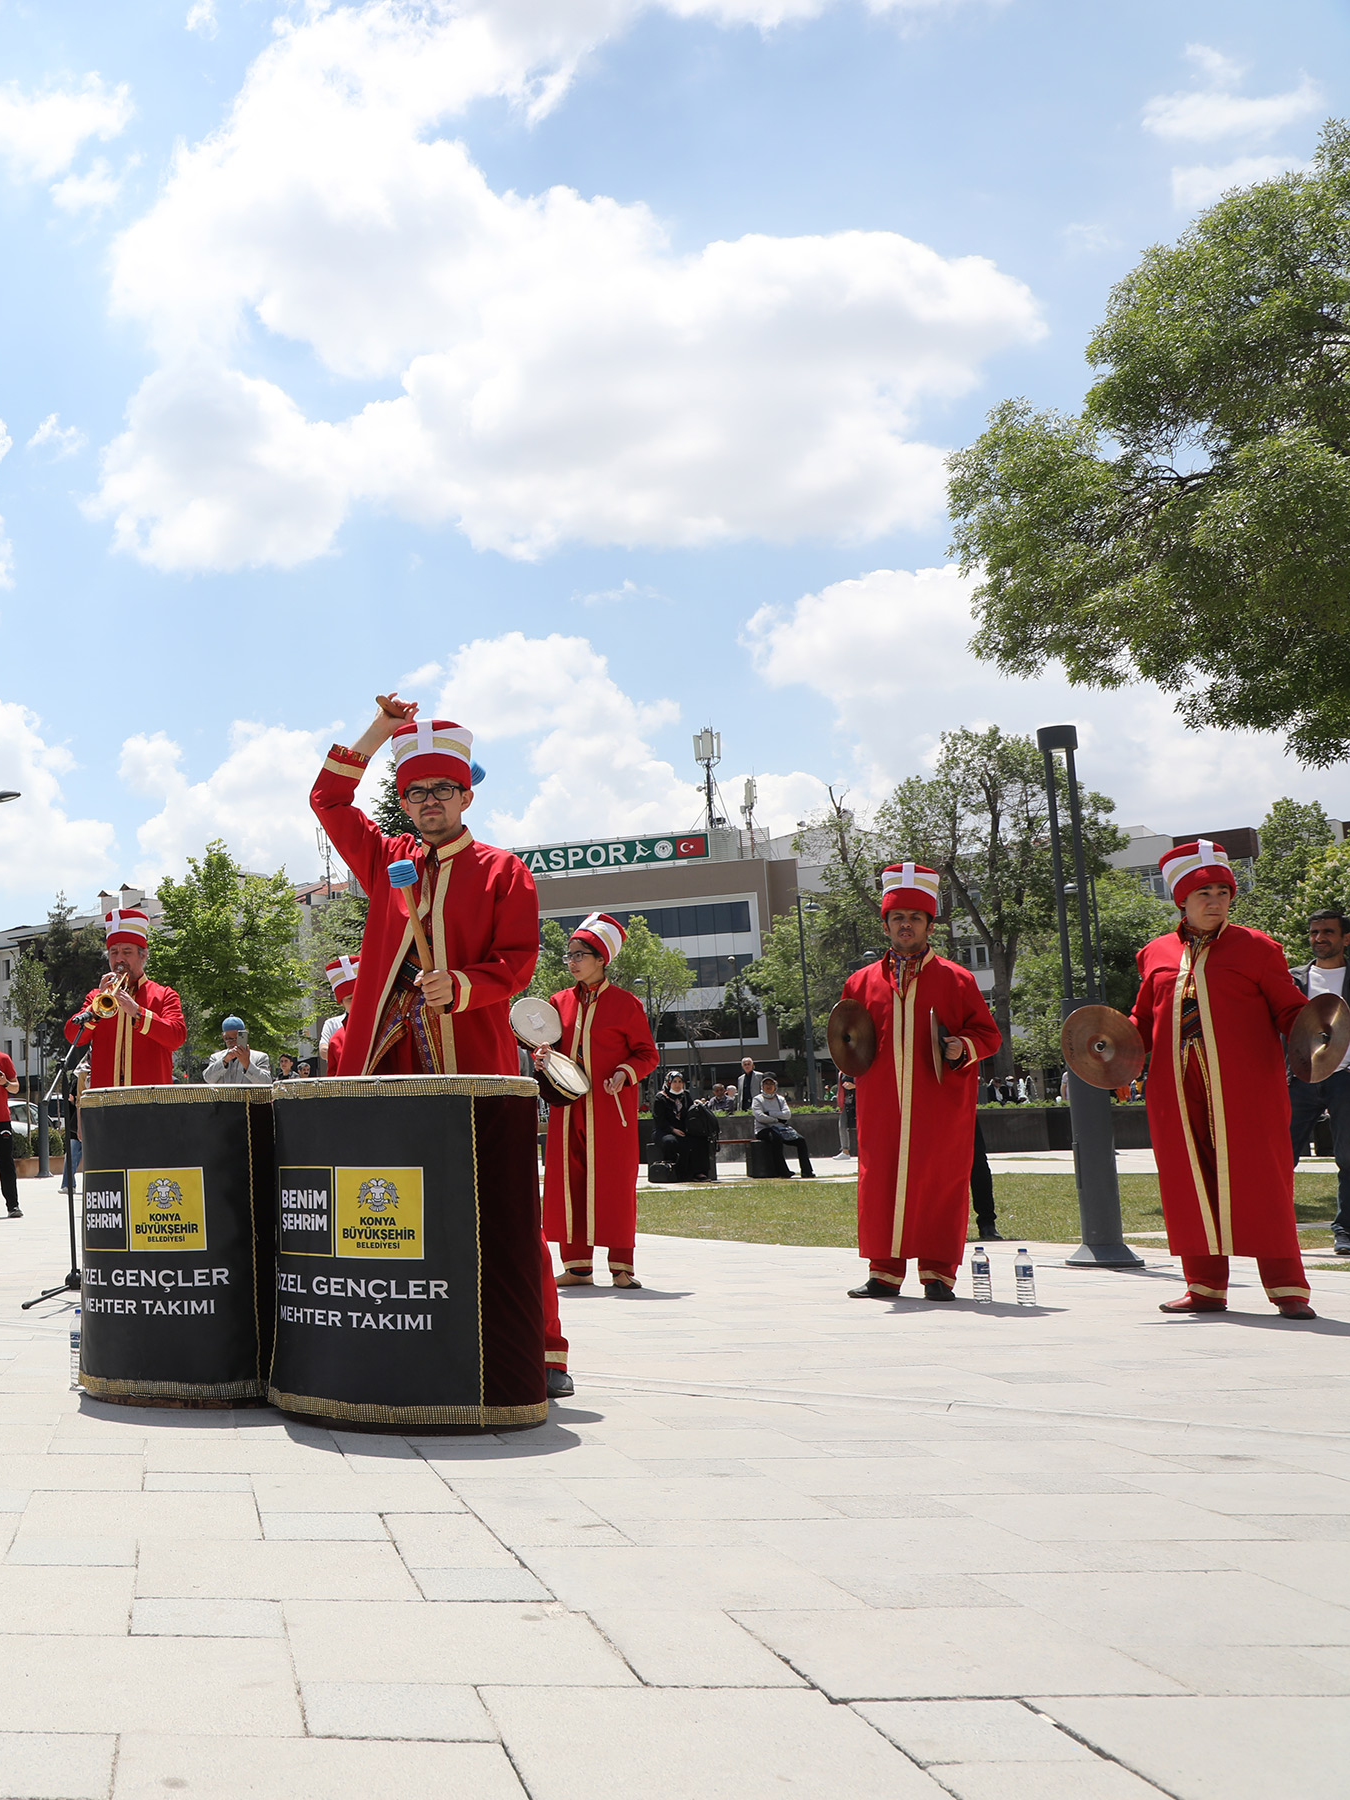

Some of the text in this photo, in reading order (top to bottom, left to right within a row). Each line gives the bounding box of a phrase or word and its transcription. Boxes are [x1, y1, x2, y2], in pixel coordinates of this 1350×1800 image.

[149, 1213, 181, 1221] KONYA
[360, 1216, 396, 1226] KONYA
[135, 1221, 199, 1236] BÜYÜKŞEHİR
[342, 1226, 416, 1241] BÜYÜKŞEHİR
[147, 1234, 186, 1243] BELEDİYESİ
[356, 1241, 400, 1250] BELEDİYESİ
[111, 1267, 230, 1293] GENÇLER
[312, 1275, 450, 1305] GENÇLER
[84, 1297, 216, 1316] MEHTER TAKIMI
[280, 1305, 433, 1331] MEHTER TAKIMI
